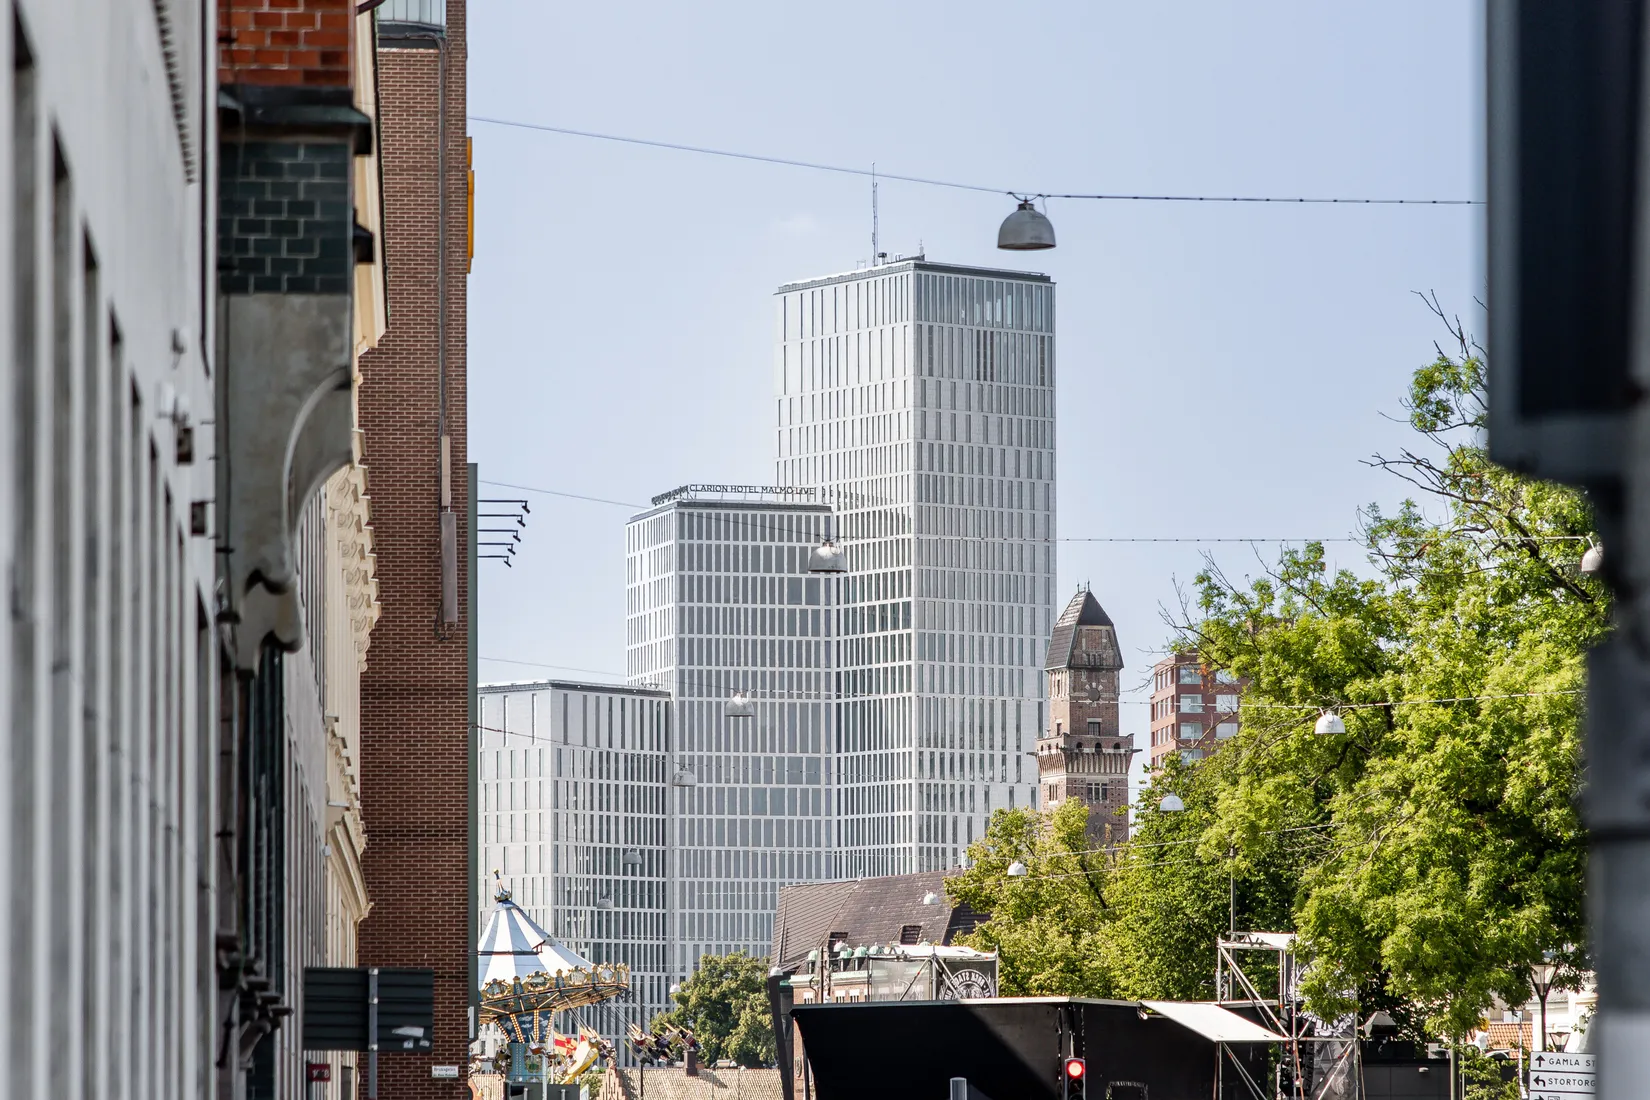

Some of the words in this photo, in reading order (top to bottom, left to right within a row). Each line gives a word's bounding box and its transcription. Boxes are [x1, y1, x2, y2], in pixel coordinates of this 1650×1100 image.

[689, 484, 728, 493] CLARION
[730, 485, 759, 493] HOTEL
[795, 487, 815, 495] LIVE
[1549, 1058, 1580, 1066] GAMLA
[1548, 1078, 1596, 1087] STORTORG
